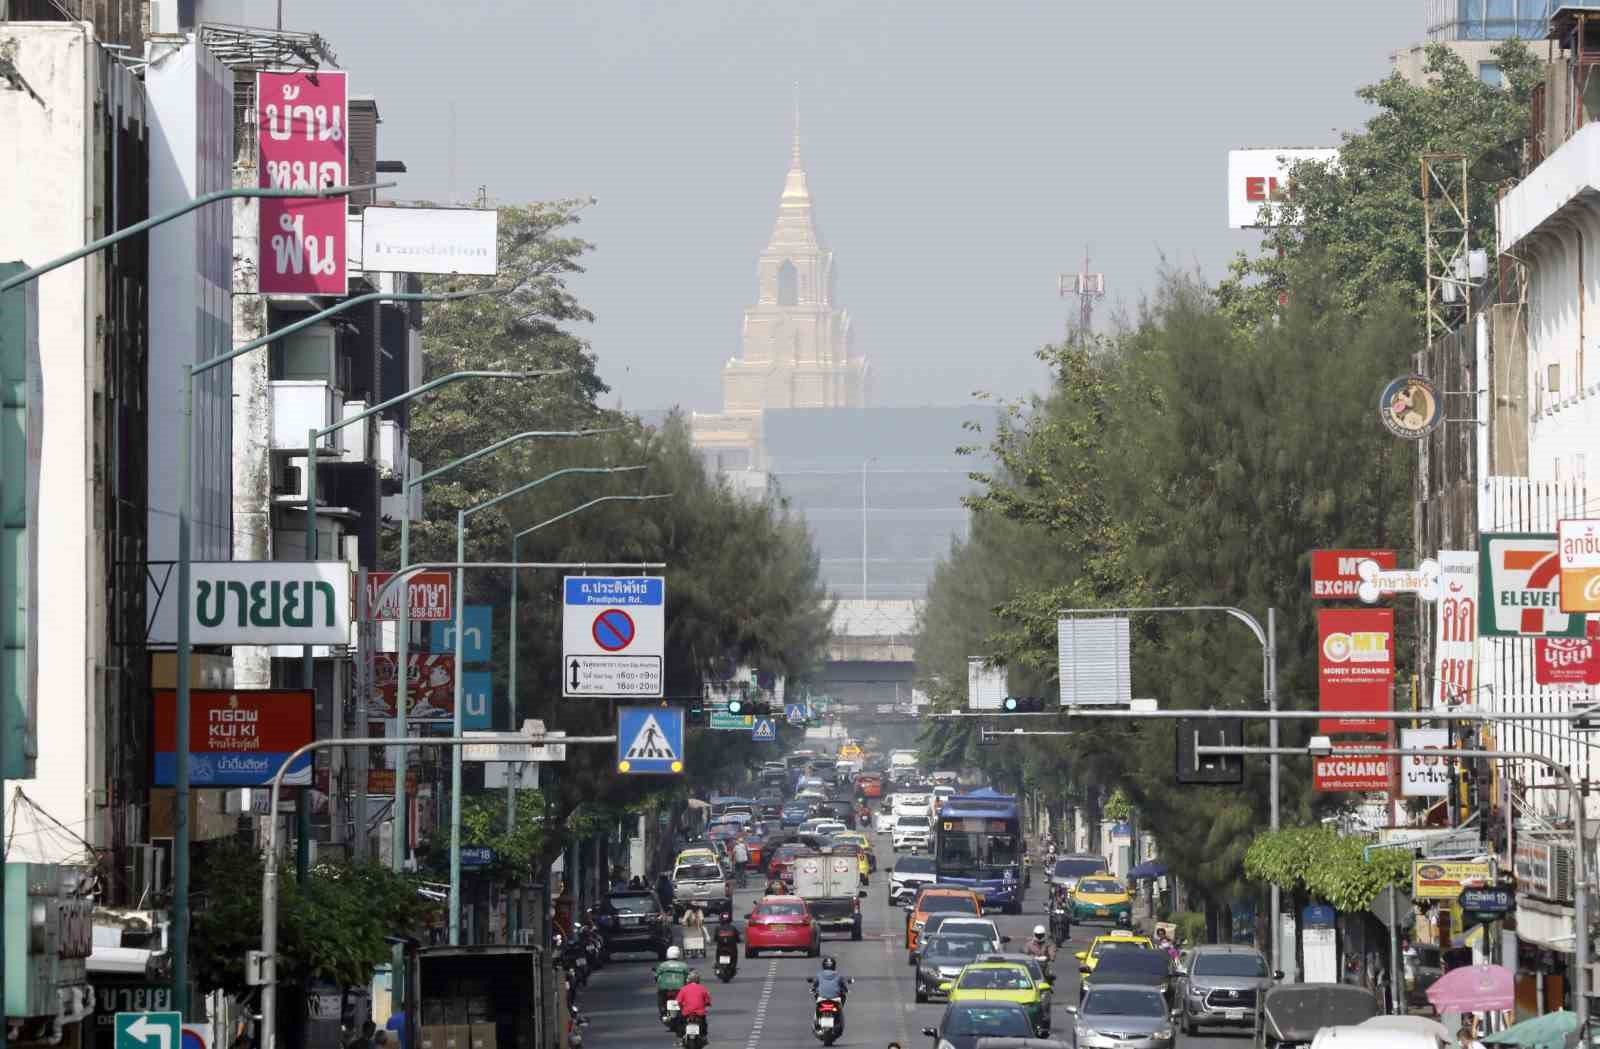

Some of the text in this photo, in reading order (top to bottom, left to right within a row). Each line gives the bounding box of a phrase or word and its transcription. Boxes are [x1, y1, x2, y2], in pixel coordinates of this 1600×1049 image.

[265, 83, 342, 142] บ้าน
[271, 213, 337, 276] ฟัน
[1564, 527, 1600, 563] ลูกชิ้
[197, 580, 336, 628] ขายยา
[208, 724, 256, 736] KUI KI
